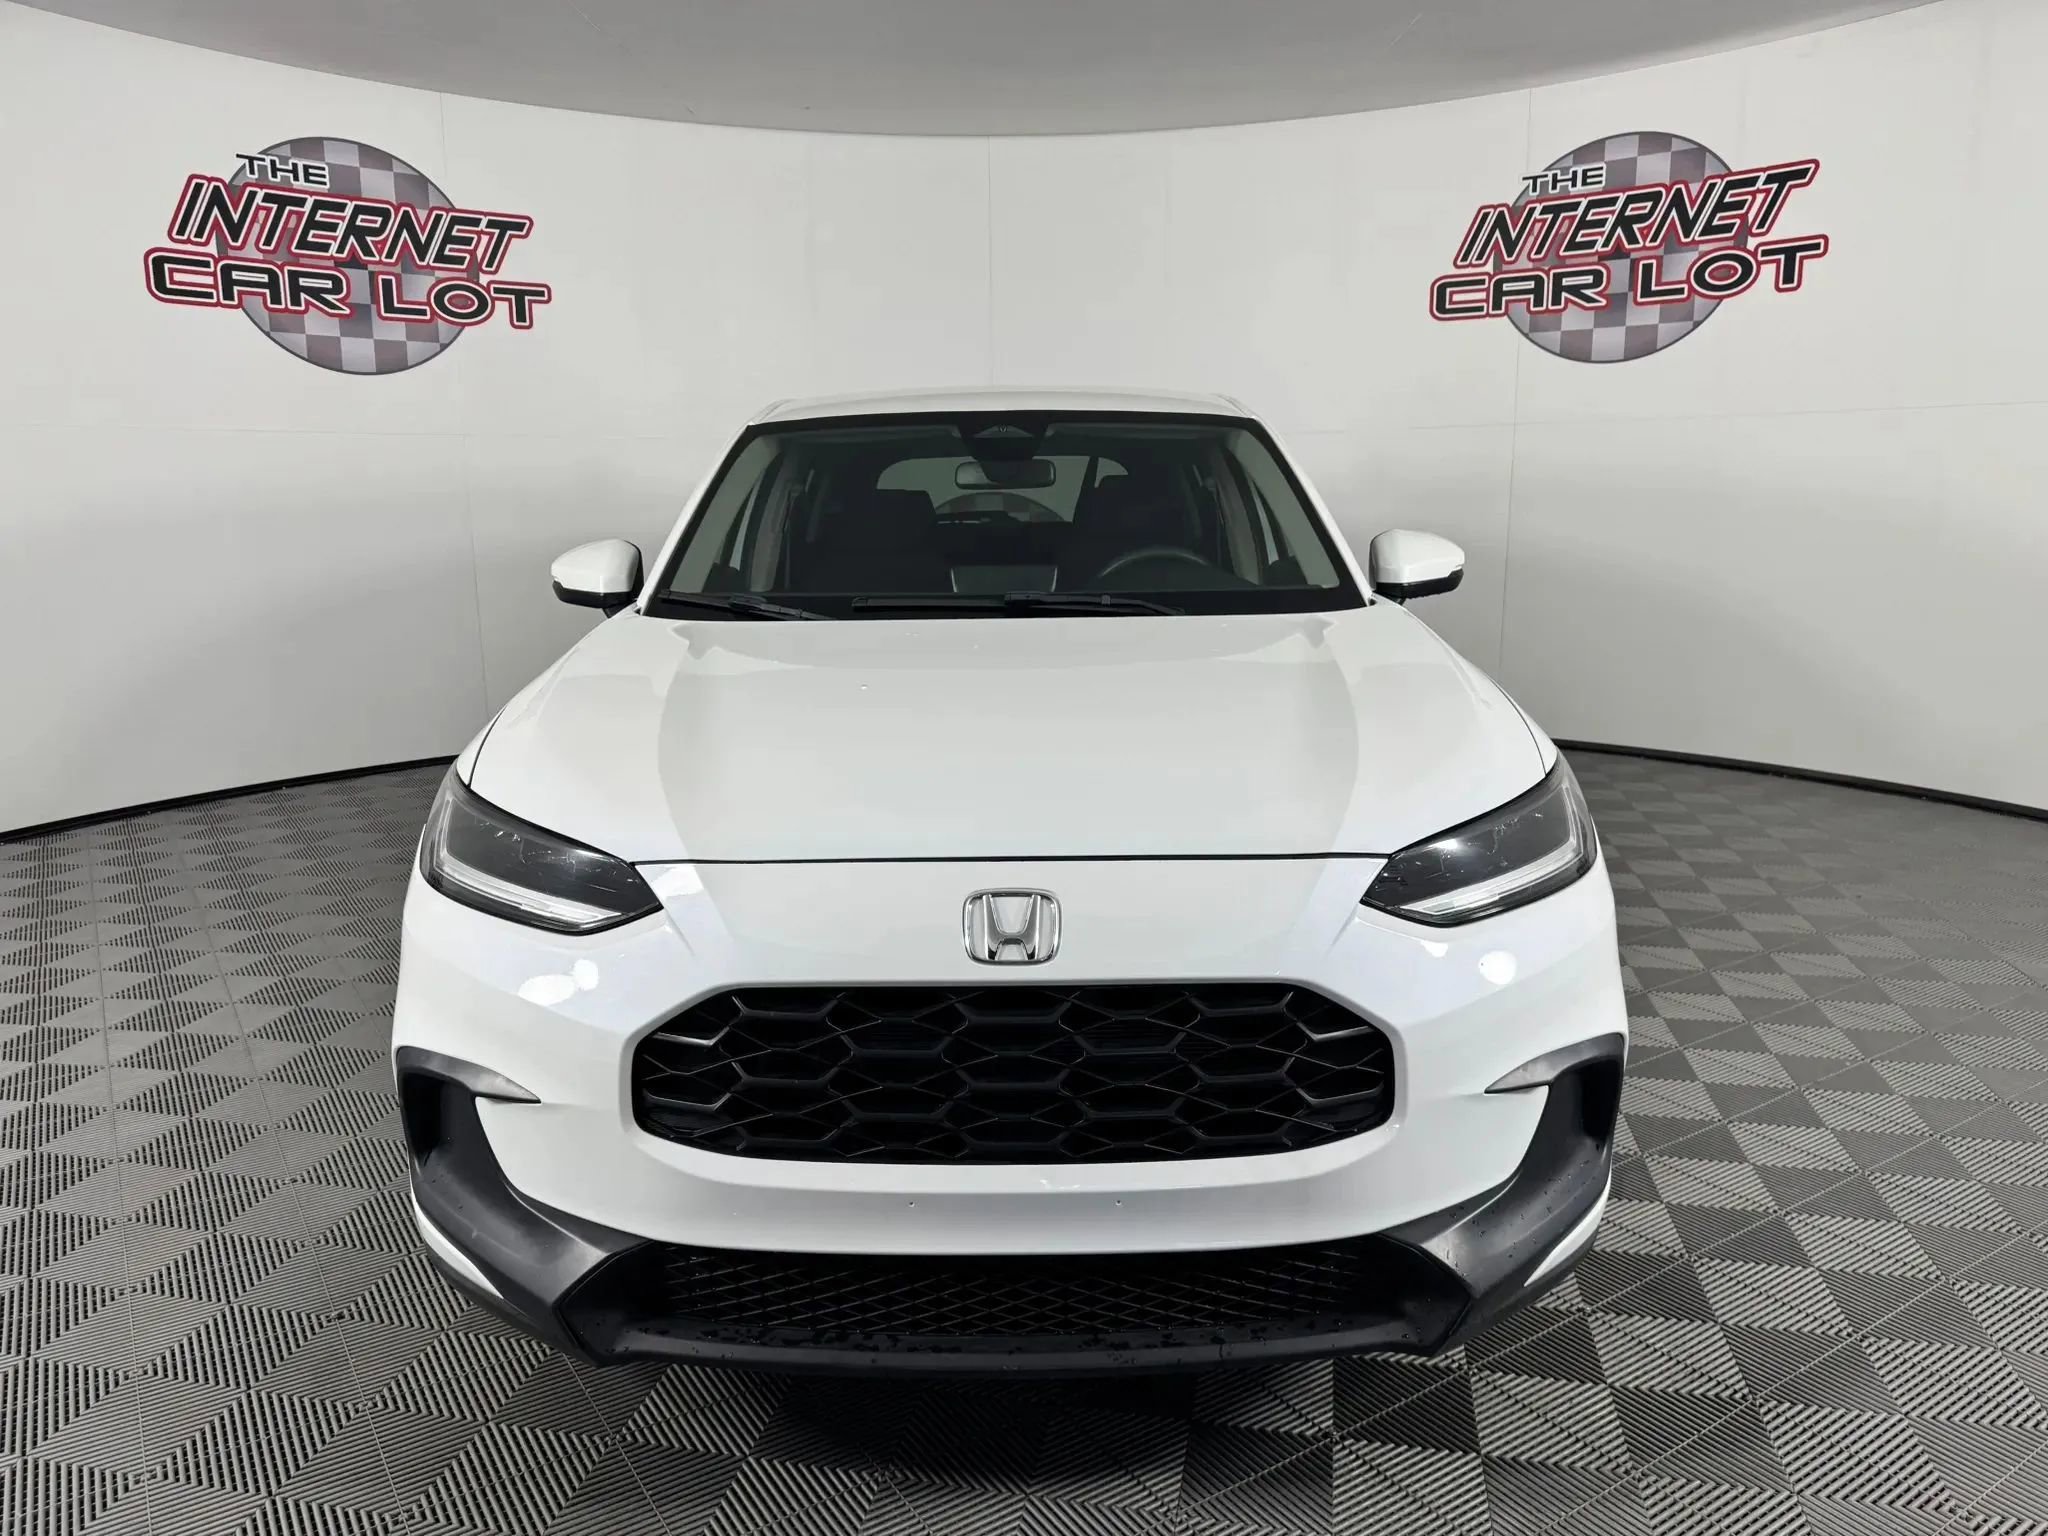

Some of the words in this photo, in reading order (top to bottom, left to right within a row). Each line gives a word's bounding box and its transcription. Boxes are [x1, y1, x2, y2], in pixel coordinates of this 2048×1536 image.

[235, 153, 329, 188] THE
[1521, 163, 1606, 195] THE
[171, 177, 530, 271] INTERNET
[1457, 162, 1816, 267] INTERNET
[147, 251, 352, 316] CAR
[378, 272, 548, 327] LOT
[1432, 264, 1610, 318] CAR
[1637, 238, 1825, 302] LOT
